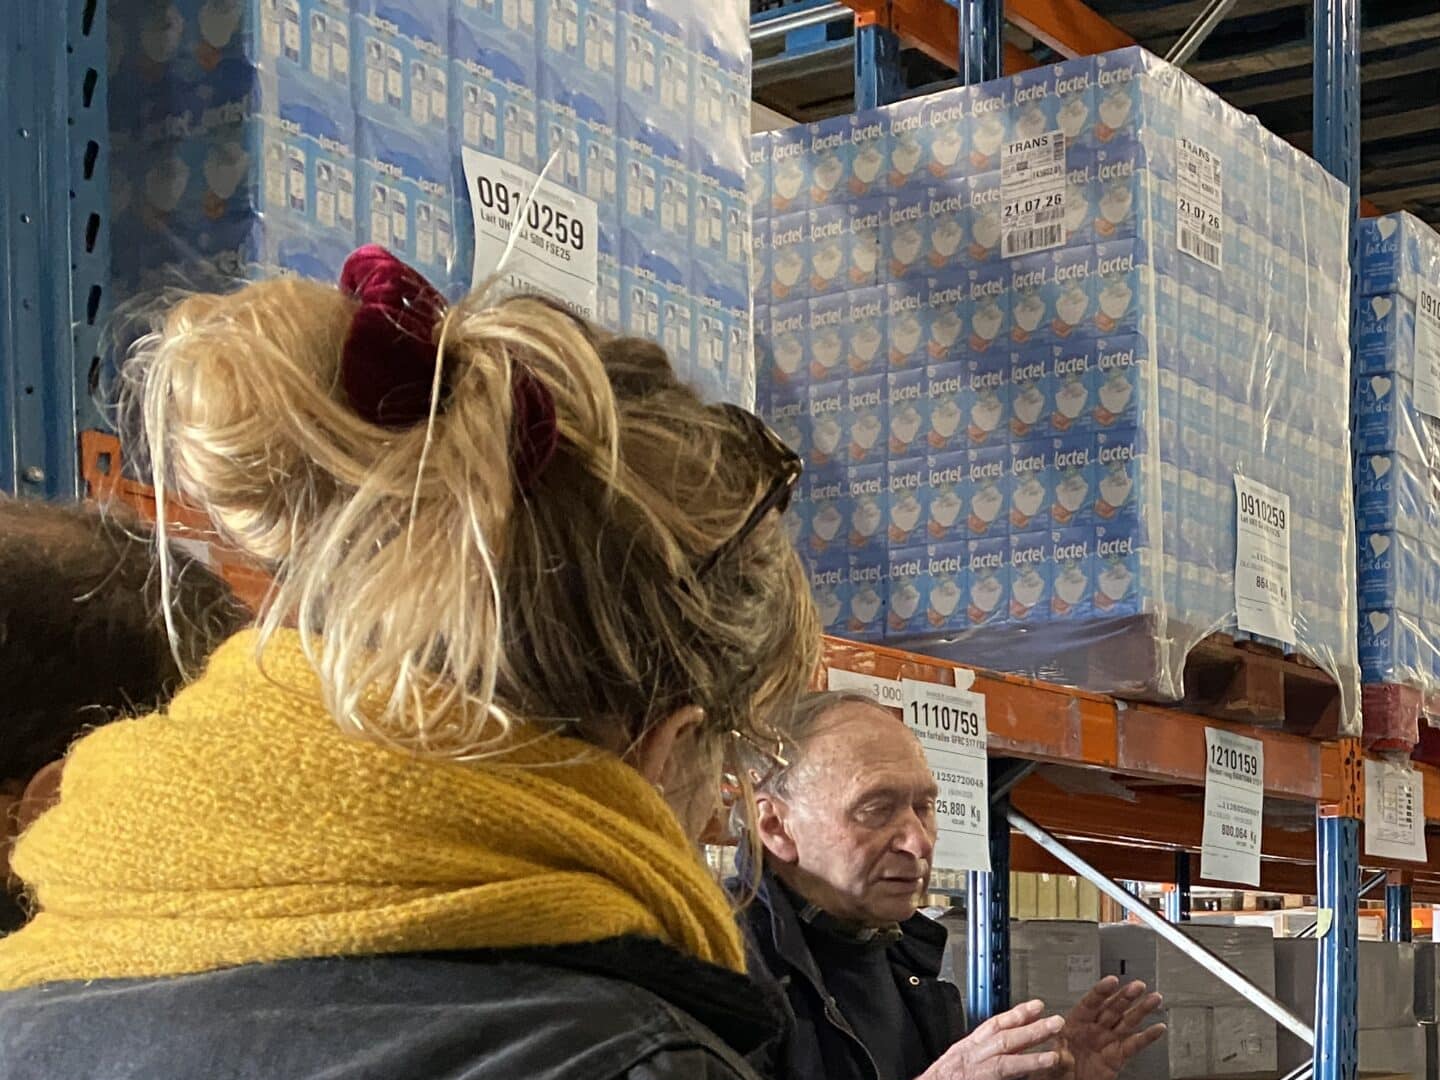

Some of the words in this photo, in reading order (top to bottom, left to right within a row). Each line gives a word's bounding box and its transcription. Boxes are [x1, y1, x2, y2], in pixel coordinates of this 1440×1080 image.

[1009, 136, 1048, 154] TRANS
[1066, 166, 1090, 185] ctel
[970, 188, 999, 206] lacte
[477, 176, 583, 250] 0910259
[1241, 492, 1285, 529] 0910259
[911, 701, 978, 736] 1110759
[1211, 744, 1257, 775] 1210159
